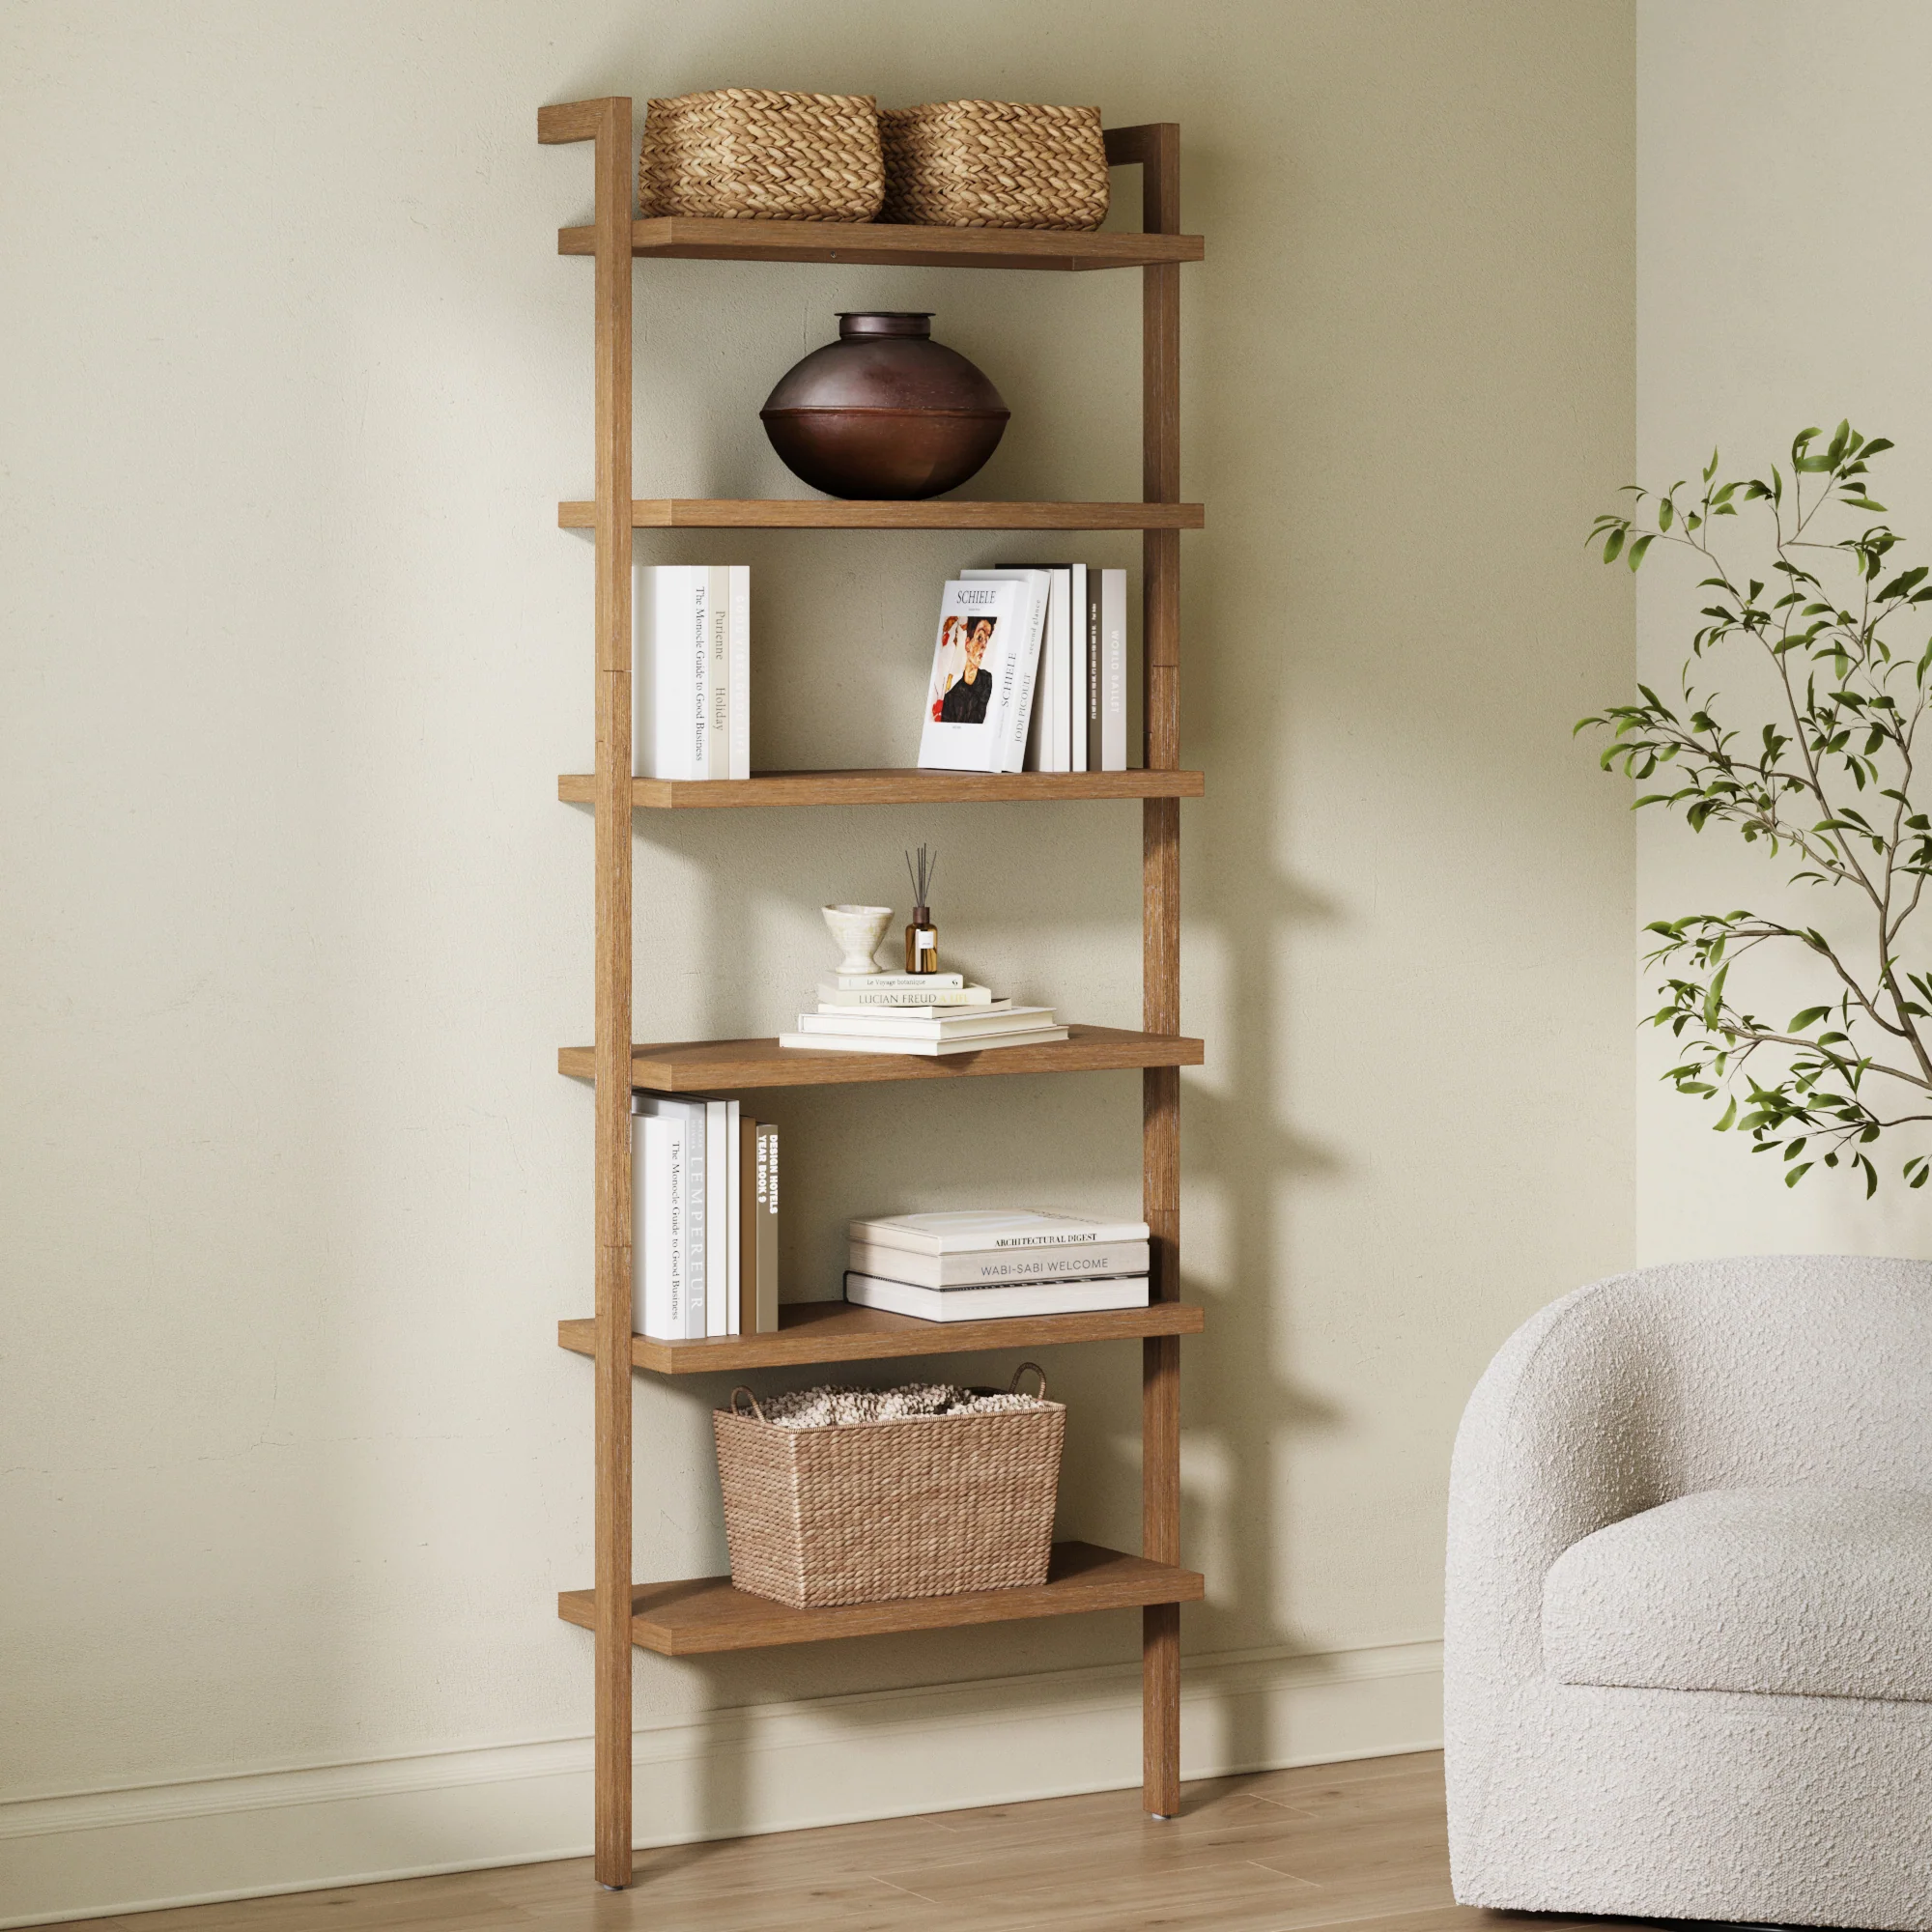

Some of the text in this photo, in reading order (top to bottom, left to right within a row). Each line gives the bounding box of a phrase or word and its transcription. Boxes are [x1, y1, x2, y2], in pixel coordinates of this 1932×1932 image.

[696, 586, 705, 605] The
[956, 590, 997, 604] SCHIELE
[696, 609, 705, 648] Monocle
[715, 611, 726, 661] Purienne
[1028, 599, 1041, 655] second glance
[696, 651, 705, 678] Guide
[1001, 652, 1016, 707] SCHIELE
[696, 694, 705, 719] Good
[713, 688, 726, 730] Holiday
[1014, 672, 1032, 743] JODI PICOULT
[696, 723, 705, 761] Business
[859, 994, 898, 1004] LUCIAN
[902, 994, 937, 1003] FREUD
[758, 1134, 767, 1162] YEAR
[758, 1165, 767, 1194] BOOK
[769, 1134, 779, 1213] DESIGN HOTELS
[672, 1141, 681, 1320] The Monocle Guide to Good Business
[691, 1156, 703, 1311] LEMPEREUR
[995, 1233, 1097, 1246] ARCHITECTURAL DIGEST
[981, 1258, 1109, 1277] WABI-SABI WELCOME
